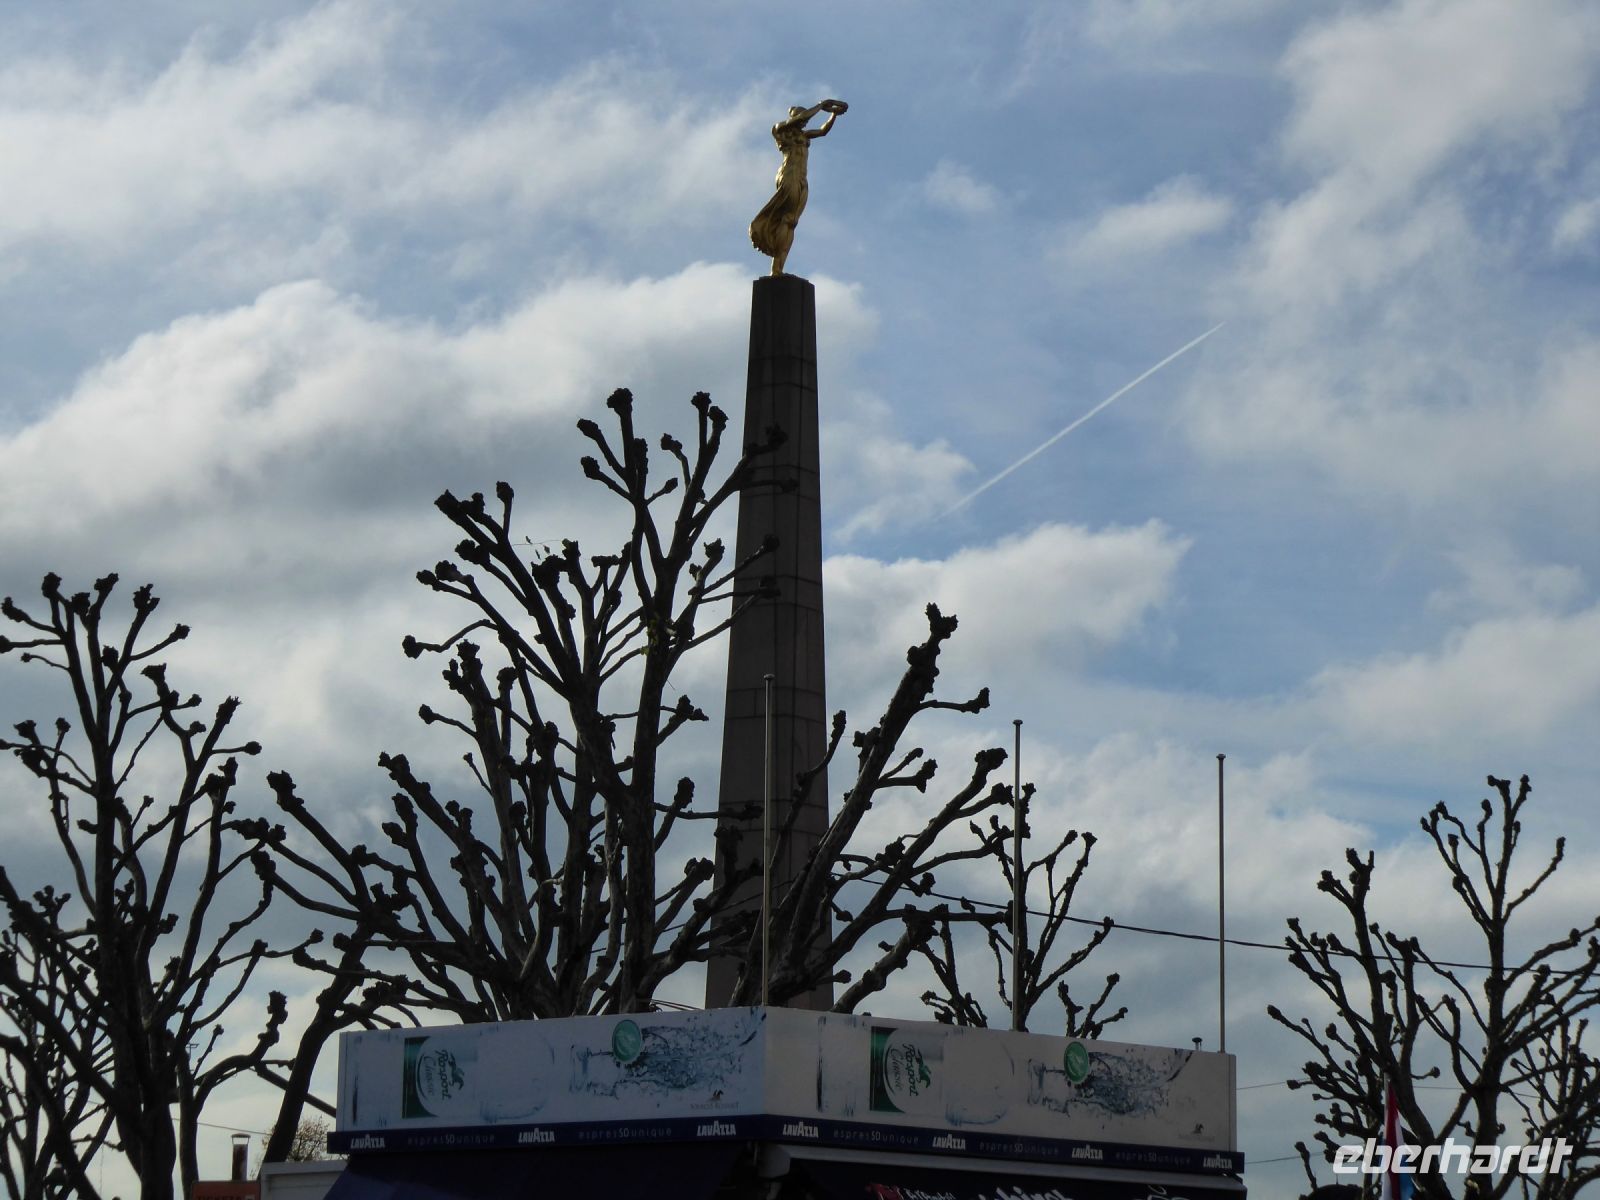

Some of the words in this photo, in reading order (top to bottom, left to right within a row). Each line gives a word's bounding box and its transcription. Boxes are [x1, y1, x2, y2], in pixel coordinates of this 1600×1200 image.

[435, 1049, 452, 1101] Rosport
[902, 1043, 919, 1097] Rosport
[350, 1134, 386, 1149] LAVAZZA
[518, 1127, 556, 1144] LAVAZZA
[696, 1120, 736, 1137] LAVAZZA
[781, 1121, 818, 1139] LAVAZZA
[932, 1133, 966, 1150] LAVAZZA
[1071, 1144, 1103, 1160] LAVAZZA
[1202, 1154, 1233, 1169] LAVAZZA
